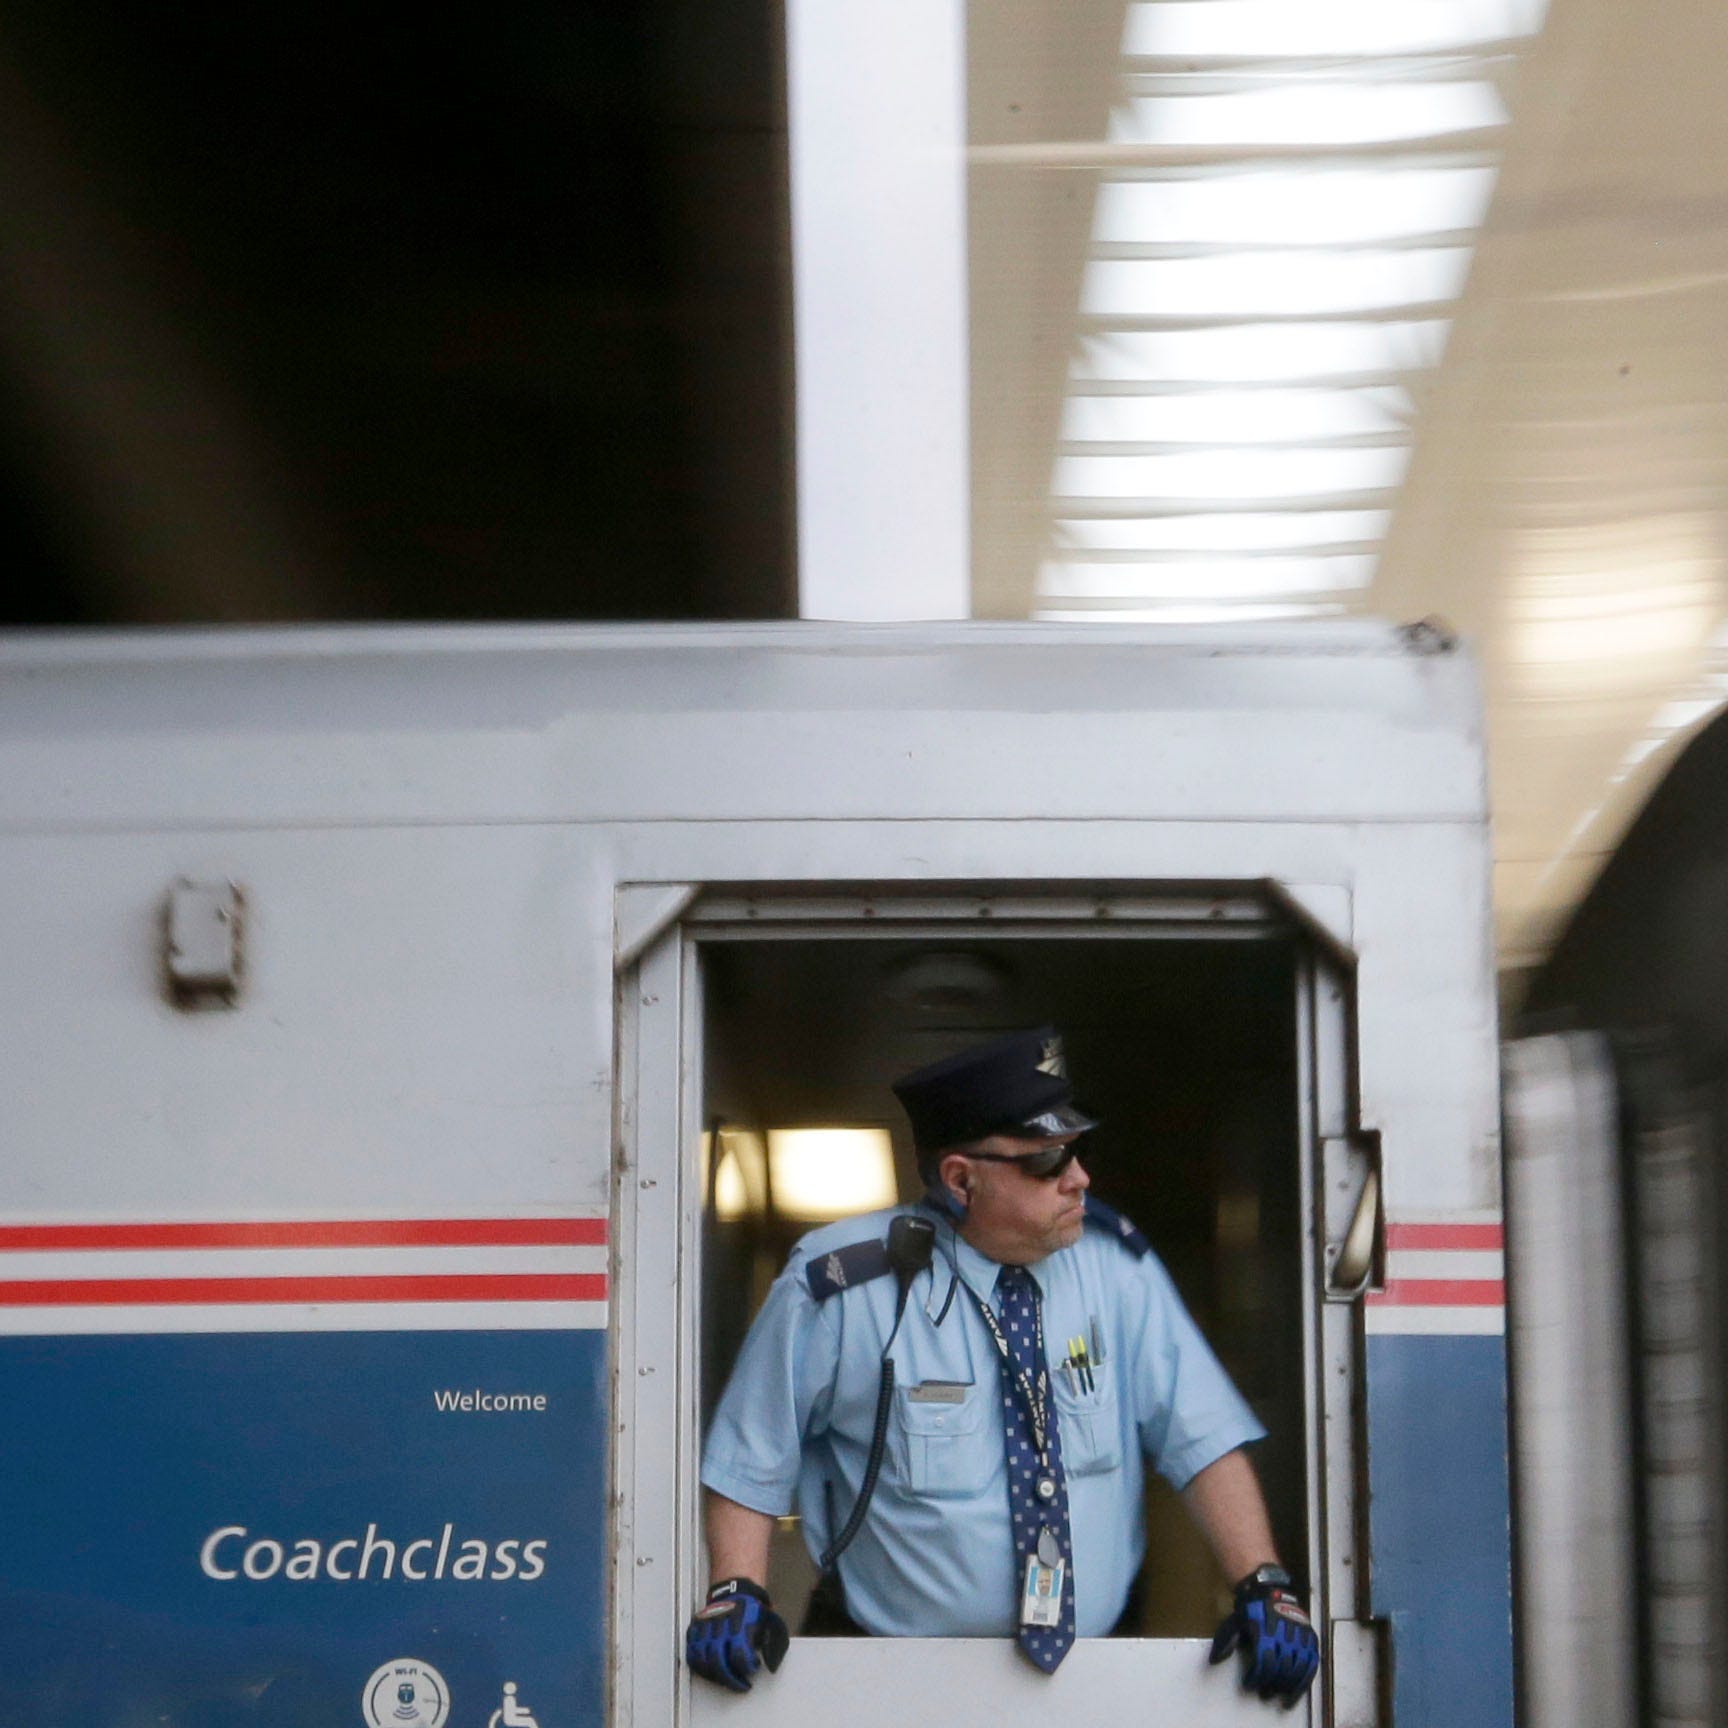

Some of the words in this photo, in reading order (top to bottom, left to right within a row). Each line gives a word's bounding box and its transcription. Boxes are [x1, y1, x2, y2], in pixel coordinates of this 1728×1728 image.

[980, 1303, 1002, 1337] AMTR
[434, 1389, 547, 1412] Welcome
[200, 1522, 548, 1580] Coachclass
